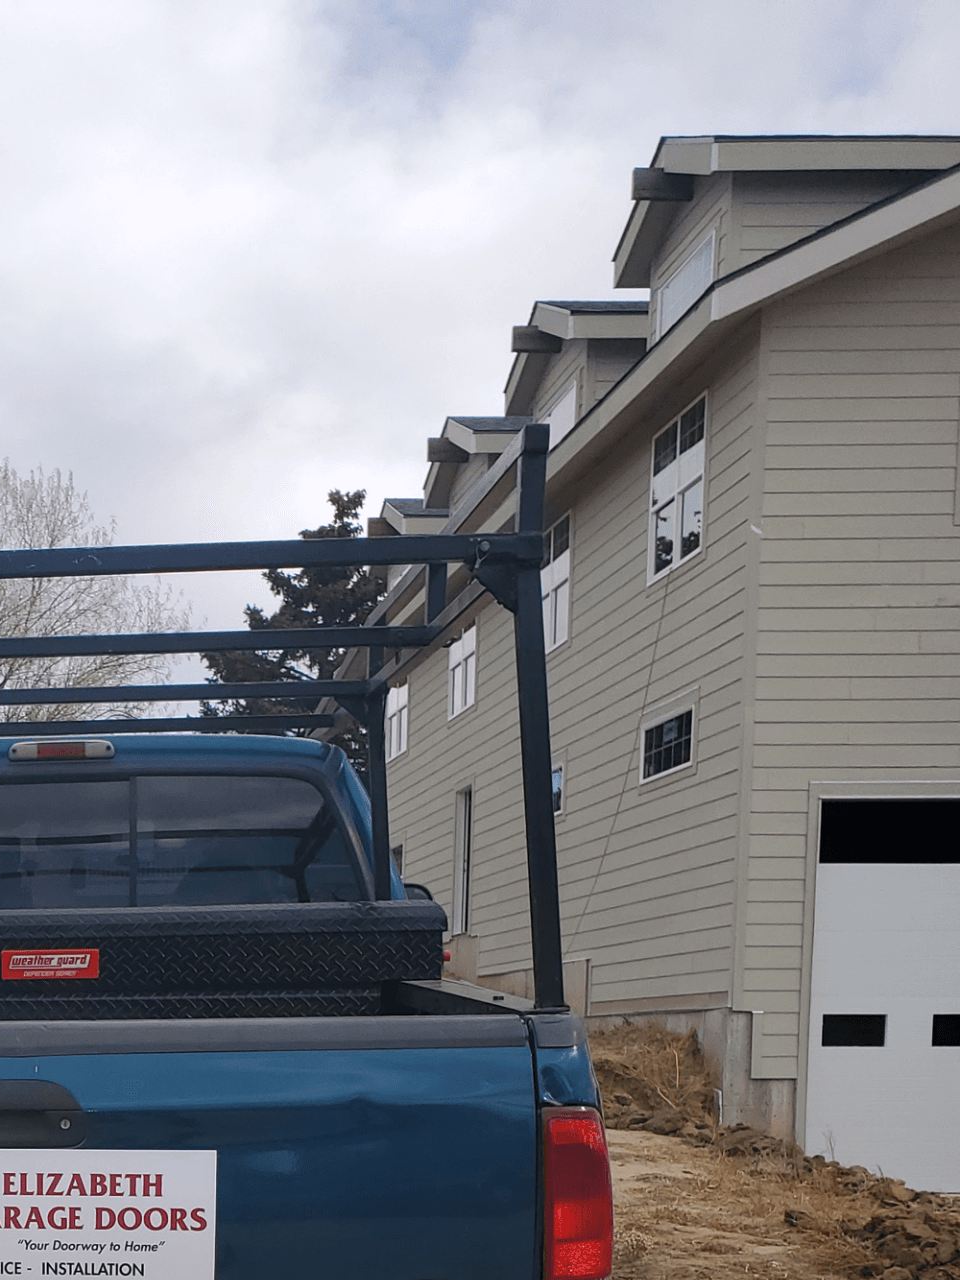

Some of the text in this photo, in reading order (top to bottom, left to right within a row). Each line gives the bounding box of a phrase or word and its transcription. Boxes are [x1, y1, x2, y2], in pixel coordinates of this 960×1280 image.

[11, 955, 87, 966] weather guard
[2, 1172, 164, 1197] ELIZABETH
[94, 1207, 208, 1232] DOORS
[52, 1240, 107, 1254] Doorway
[109, 1241, 121, 1252] to
[42, 1262, 145, 1277] INSTALLATION
